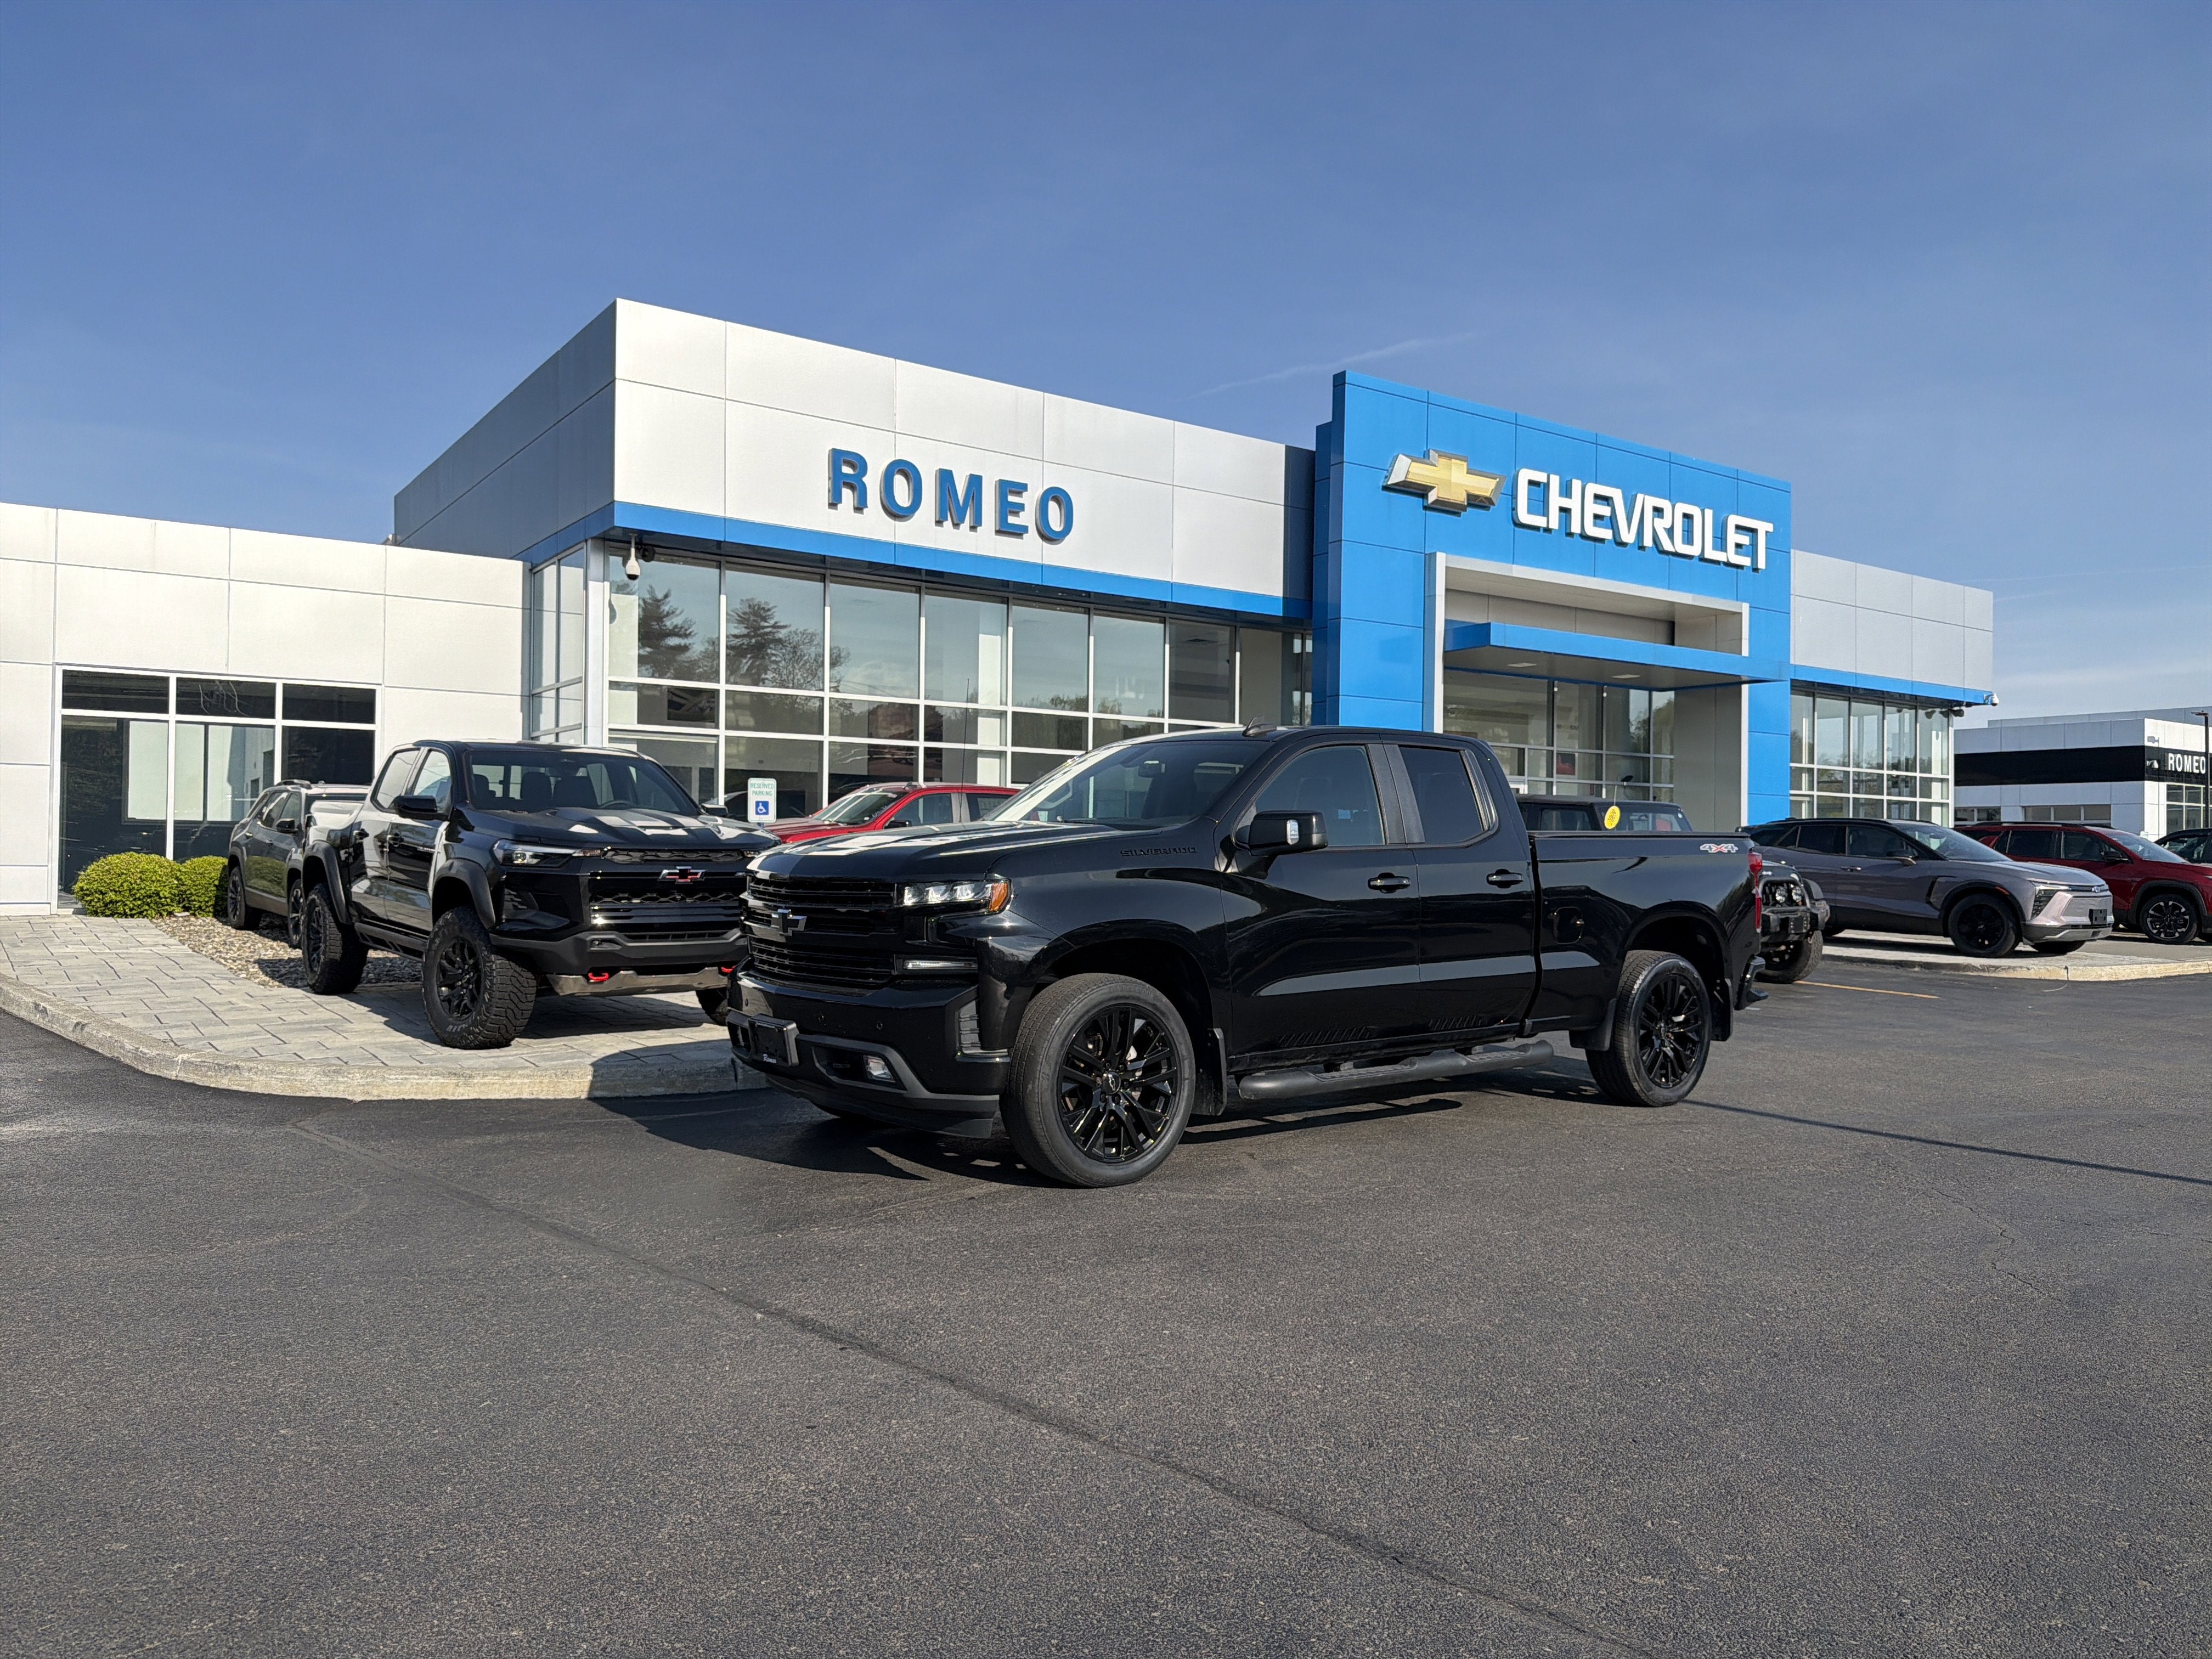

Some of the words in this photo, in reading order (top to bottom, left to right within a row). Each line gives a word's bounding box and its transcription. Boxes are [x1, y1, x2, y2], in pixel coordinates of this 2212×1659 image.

[828, 448, 1074, 541] ROMEO
[1515, 468, 1773, 570] CHEVROLET
[2168, 753, 2206, 774] ROMEO
[1120, 847, 1198, 857] SILVERADO
